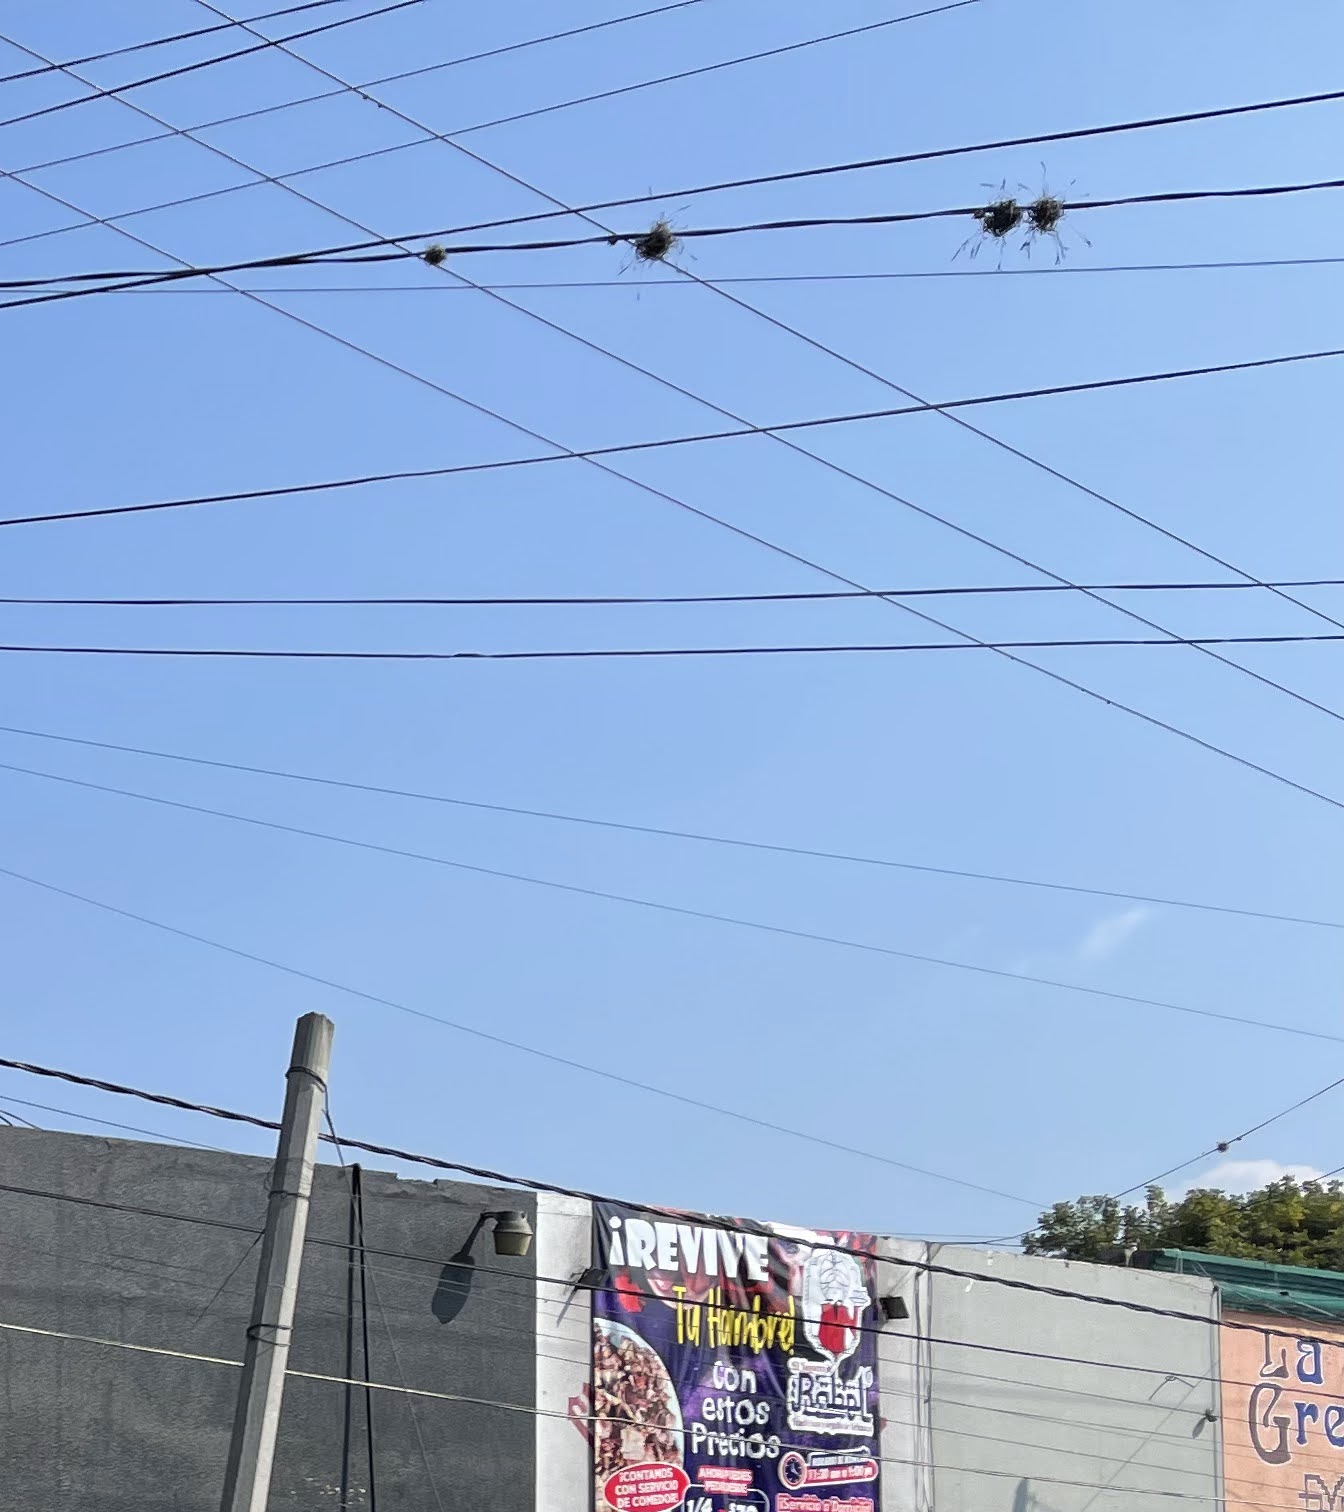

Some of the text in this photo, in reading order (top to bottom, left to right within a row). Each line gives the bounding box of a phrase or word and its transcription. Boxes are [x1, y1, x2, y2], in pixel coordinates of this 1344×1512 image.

[673, 1285, 795, 1355] Tu Hambre!
[1260, 1333, 1324, 1385] La
[702, 1395, 771, 1425] estos
[691, 1423, 781, 1459] Precios
[615, 1480, 678, 1495] CON SERVICIO
[617, 1498, 631, 1508] DE
